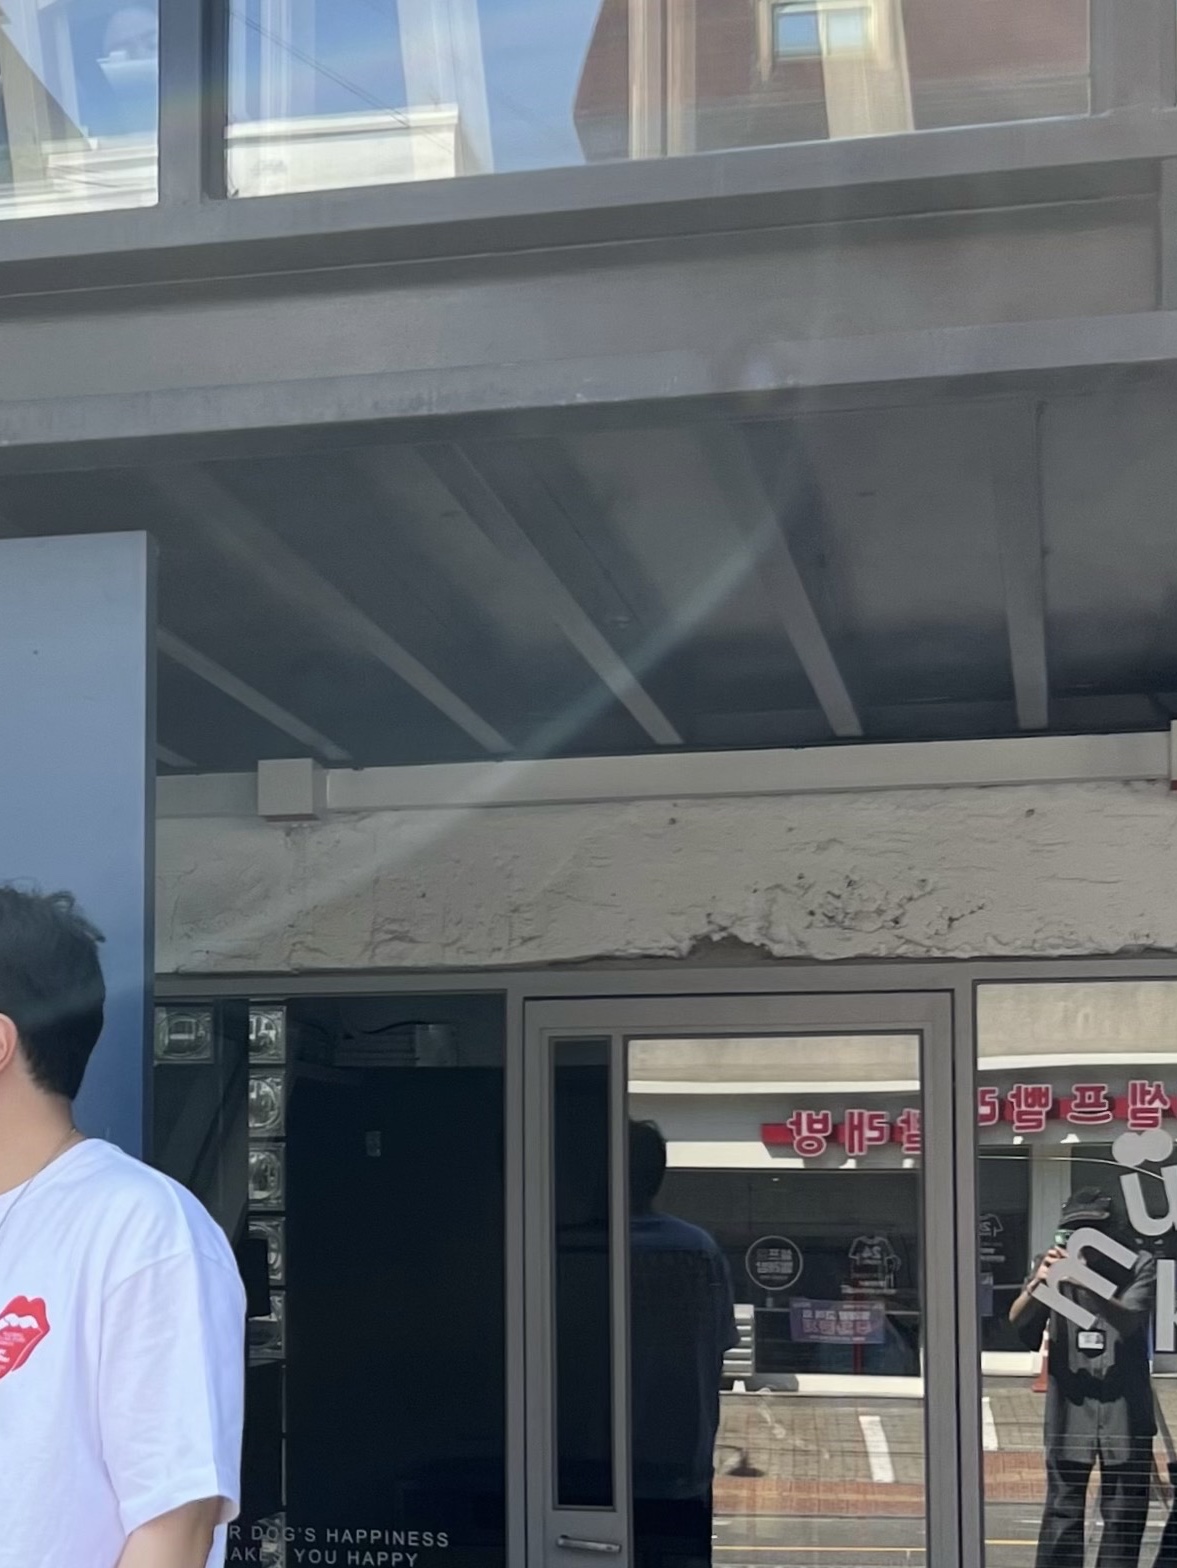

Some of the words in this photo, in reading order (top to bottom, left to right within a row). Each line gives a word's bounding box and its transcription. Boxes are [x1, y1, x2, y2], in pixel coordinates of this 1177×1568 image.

[251, 1526, 316, 1542] DOG'S
[326, 1528, 450, 1548] HAPPINESS
[294, 1548, 337, 1565] YOU
[347, 1551, 418, 1568] HAPPY
